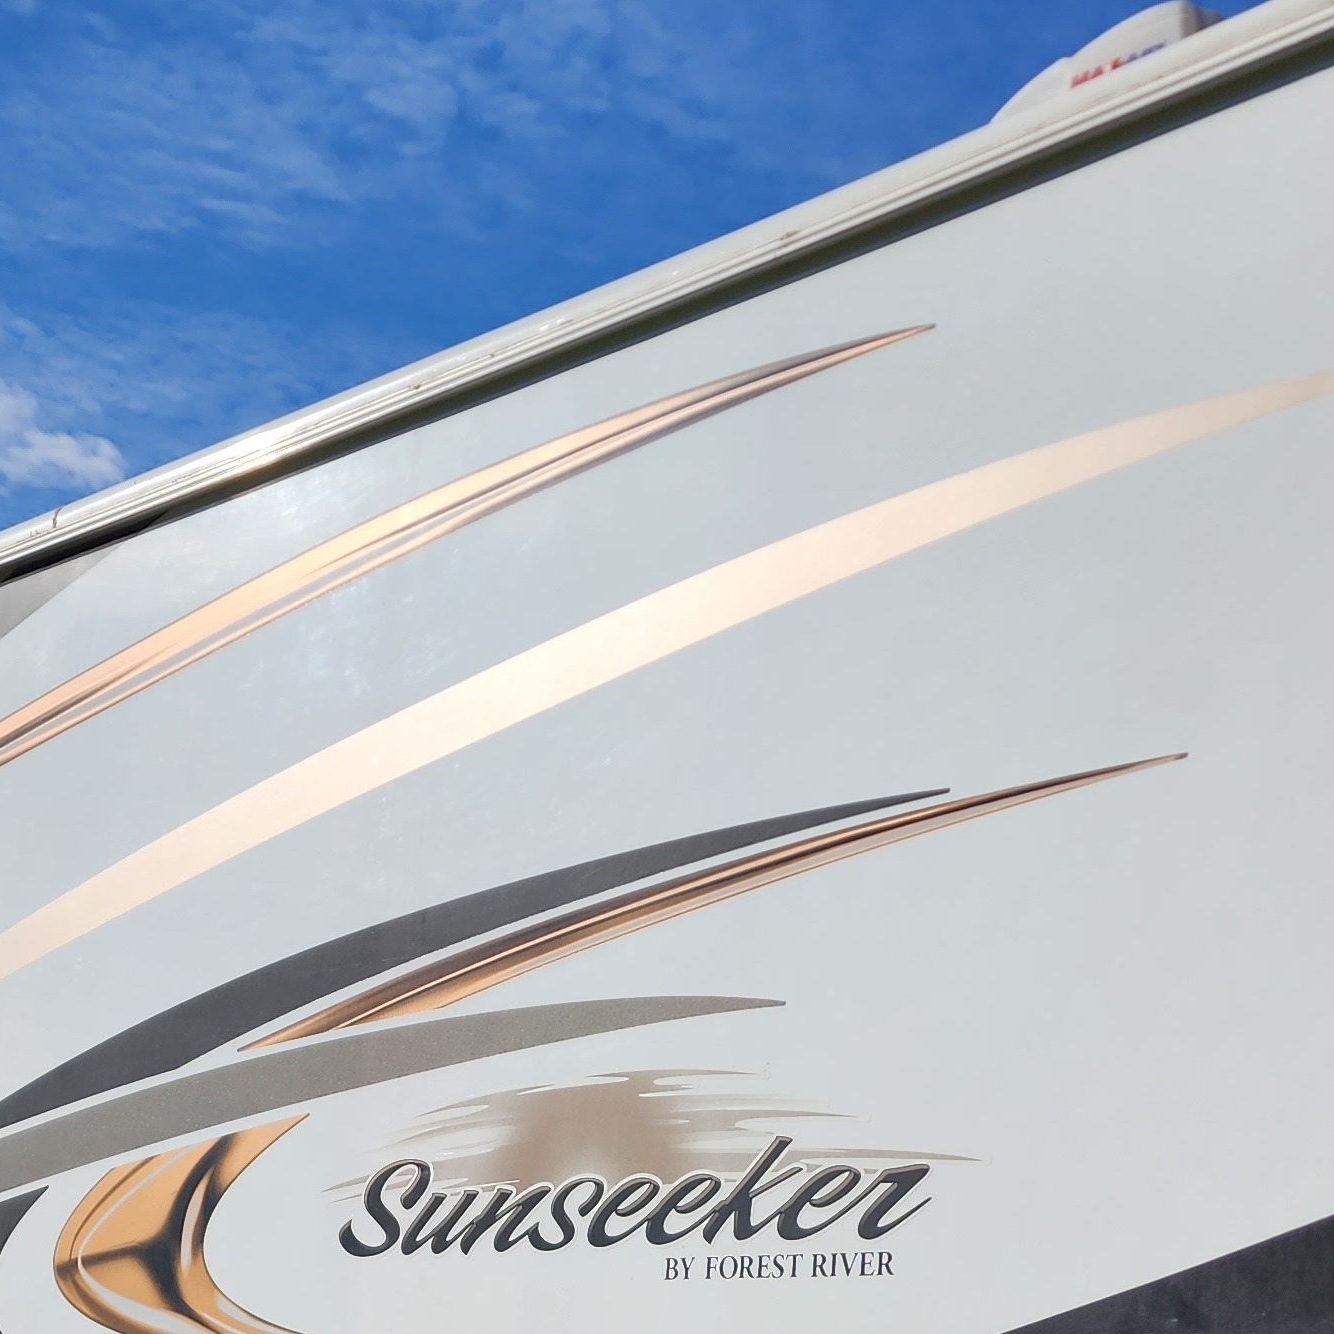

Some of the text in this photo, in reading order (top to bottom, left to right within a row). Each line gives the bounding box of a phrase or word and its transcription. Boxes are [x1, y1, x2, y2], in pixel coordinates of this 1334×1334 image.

[338, 1136, 932, 1257] Sunseeker
[664, 1251, 894, 1280] BY FOREST RIVER
